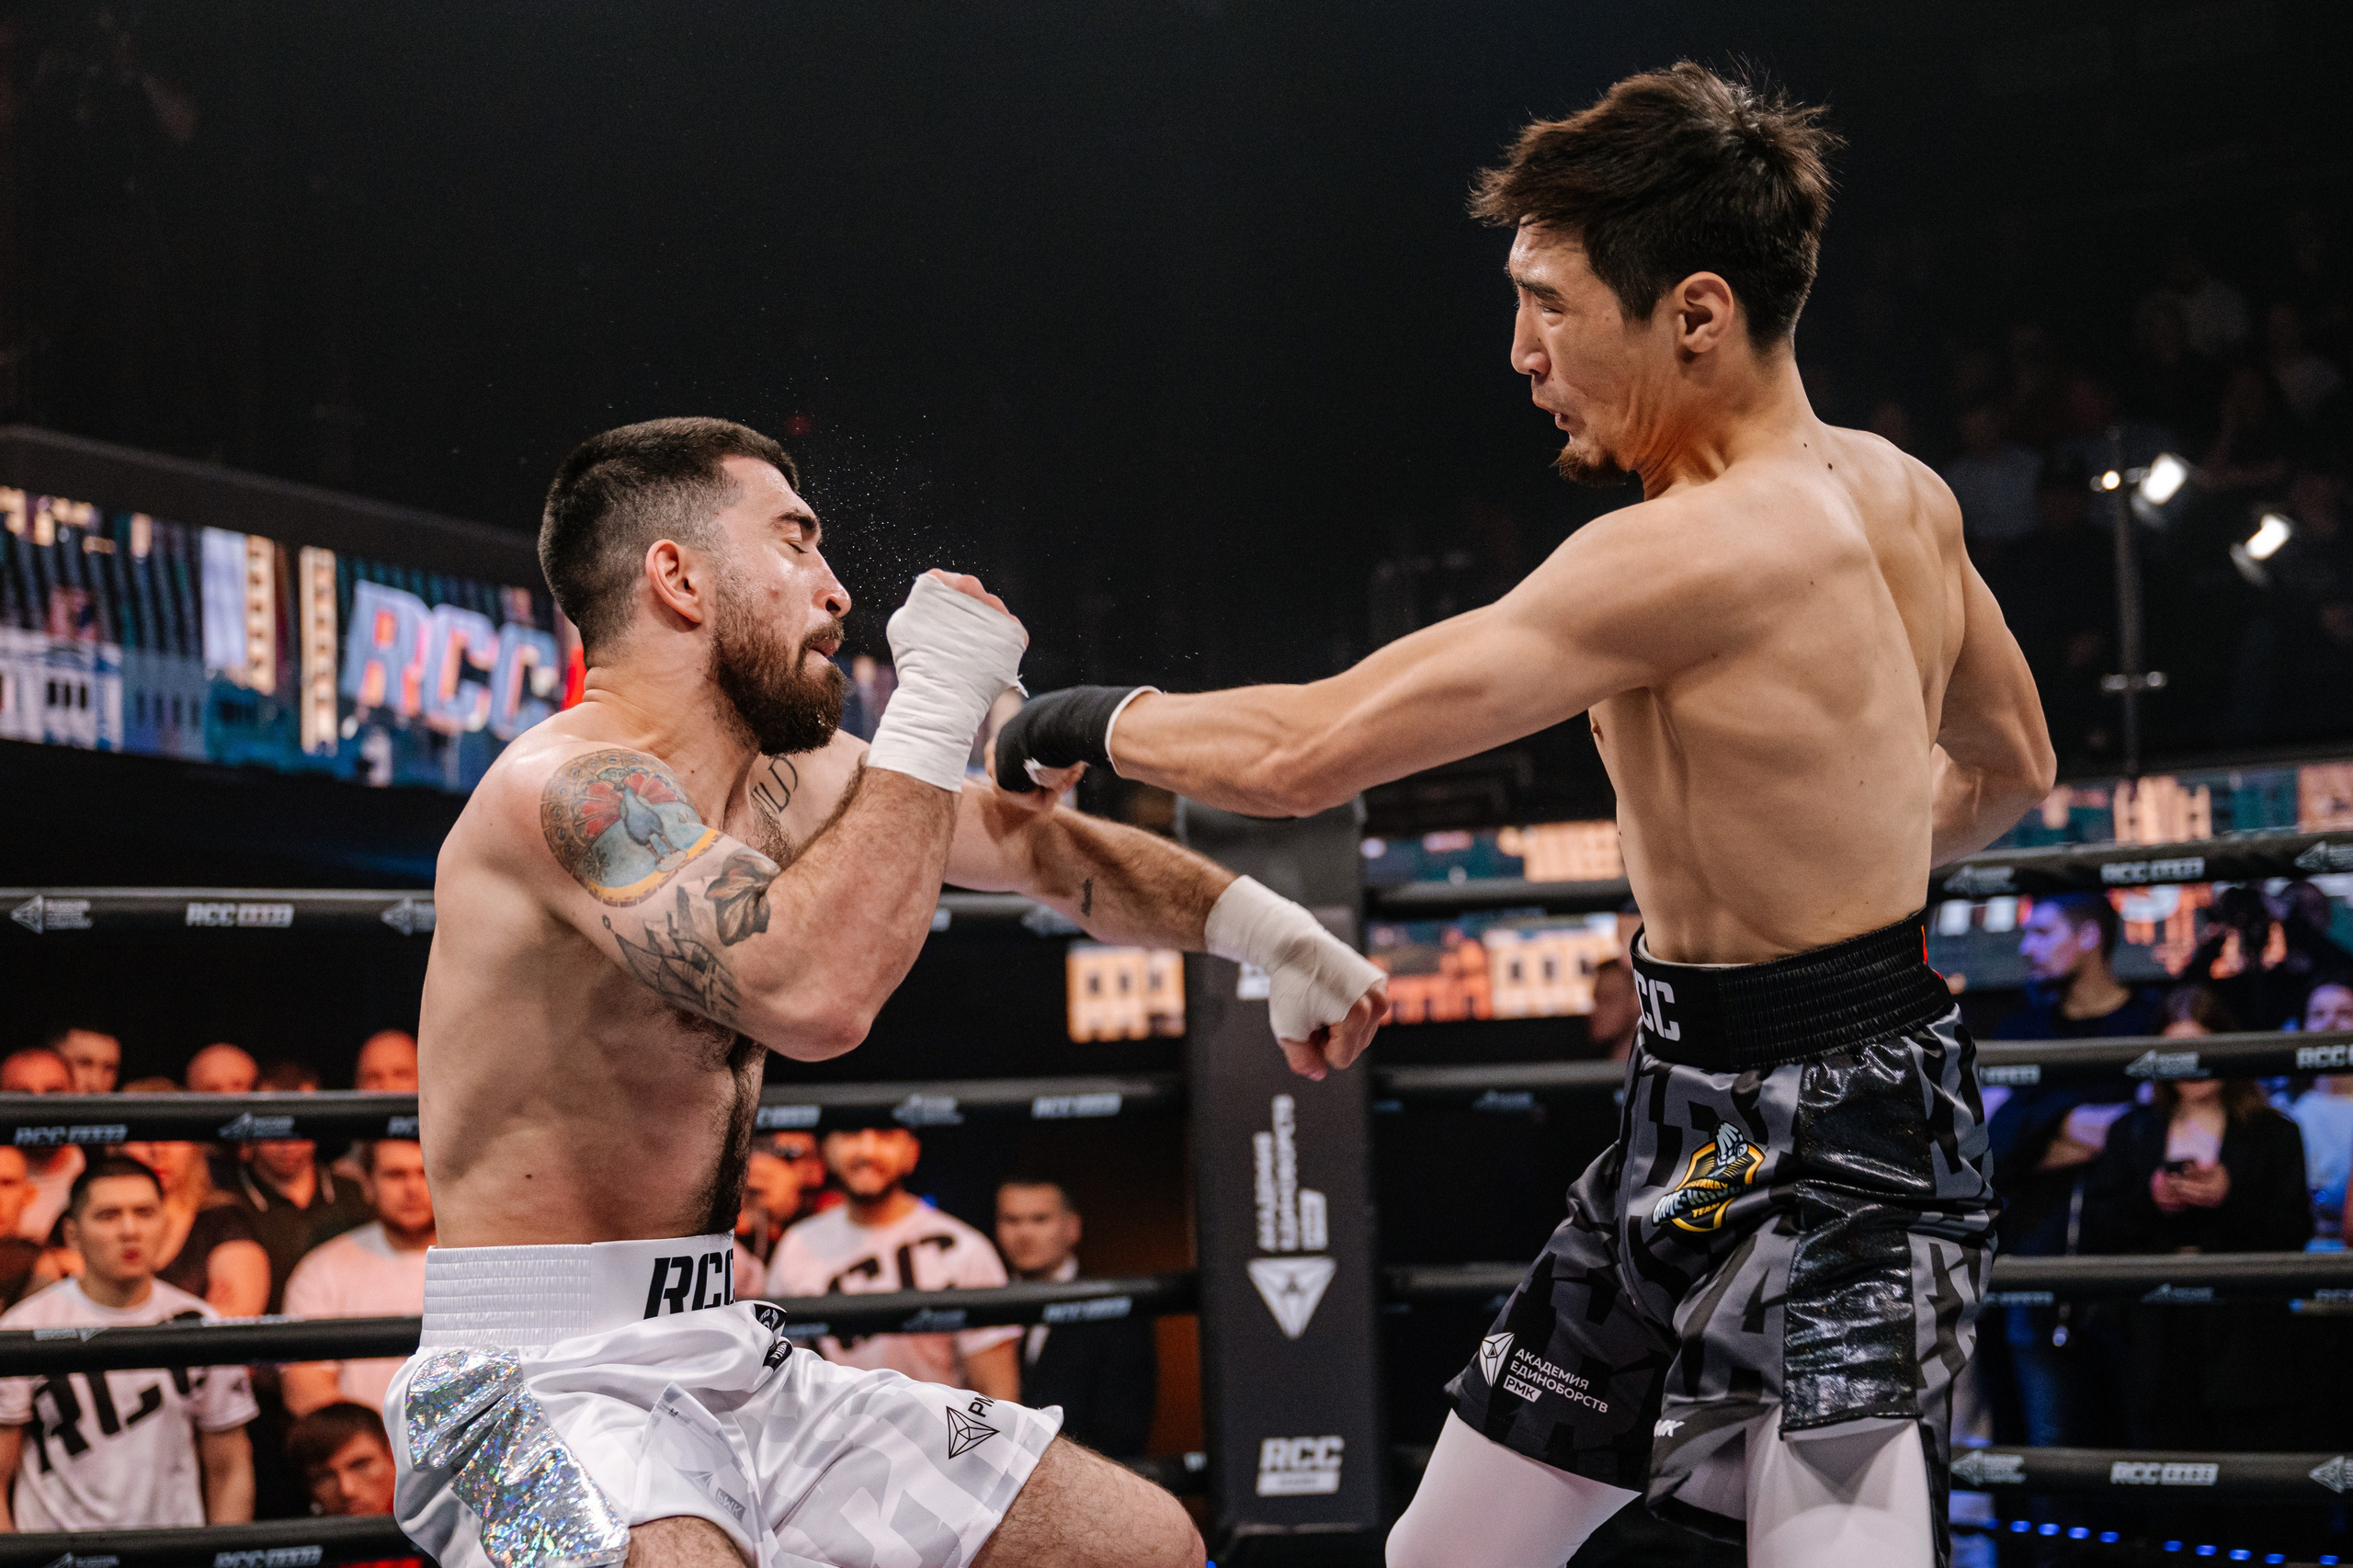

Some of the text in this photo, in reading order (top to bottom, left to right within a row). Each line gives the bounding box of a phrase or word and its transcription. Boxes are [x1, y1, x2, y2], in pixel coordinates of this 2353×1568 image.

[341, 579, 558, 738] RCC
[1633, 969, 1681, 1042] CC
[1505, 1379, 1538, 1402] РМК
[1509, 1360, 1609, 1414] ЕДИНОБОРСТВ
[1515, 1348, 1590, 1391] АКАДЕМИЯ
